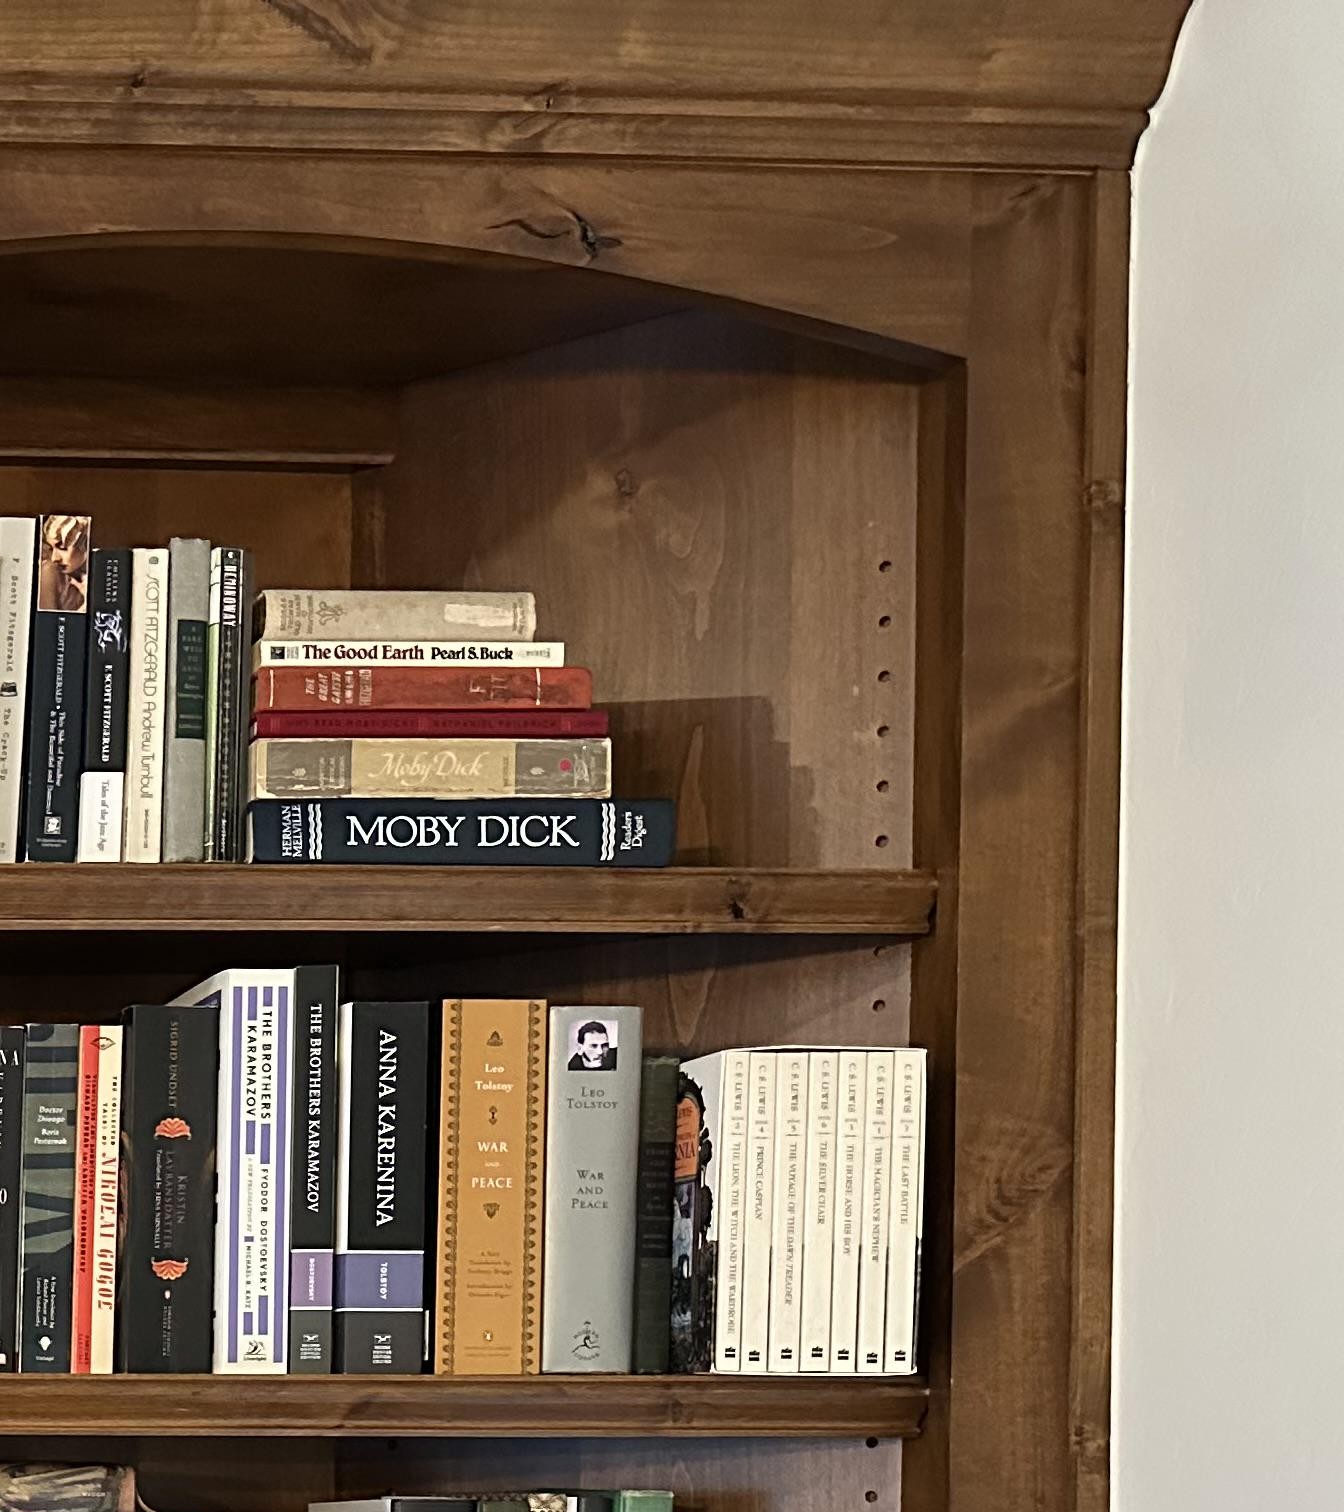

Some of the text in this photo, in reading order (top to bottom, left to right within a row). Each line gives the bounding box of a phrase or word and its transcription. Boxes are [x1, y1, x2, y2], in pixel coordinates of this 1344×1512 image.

[302, 644, 331, 660] The
[334, 645, 378, 660] Good
[382, 645, 424, 660] Earth
[431, 647, 465, 660] Pearl
[480, 646, 513, 661] Buck
[282, 805, 291, 858] HERMAN
[293, 805, 302, 858] MELVILLE
[346, 815, 579, 847] MOBY DICK
[306, 1004, 322, 1212] THE BROTHERS KARAMAZOV
[376, 1030, 397, 1227] ANNA KARENINA
[477, 1141, 509, 1153] WAR
[471, 1177, 512, 1189] PEACE
